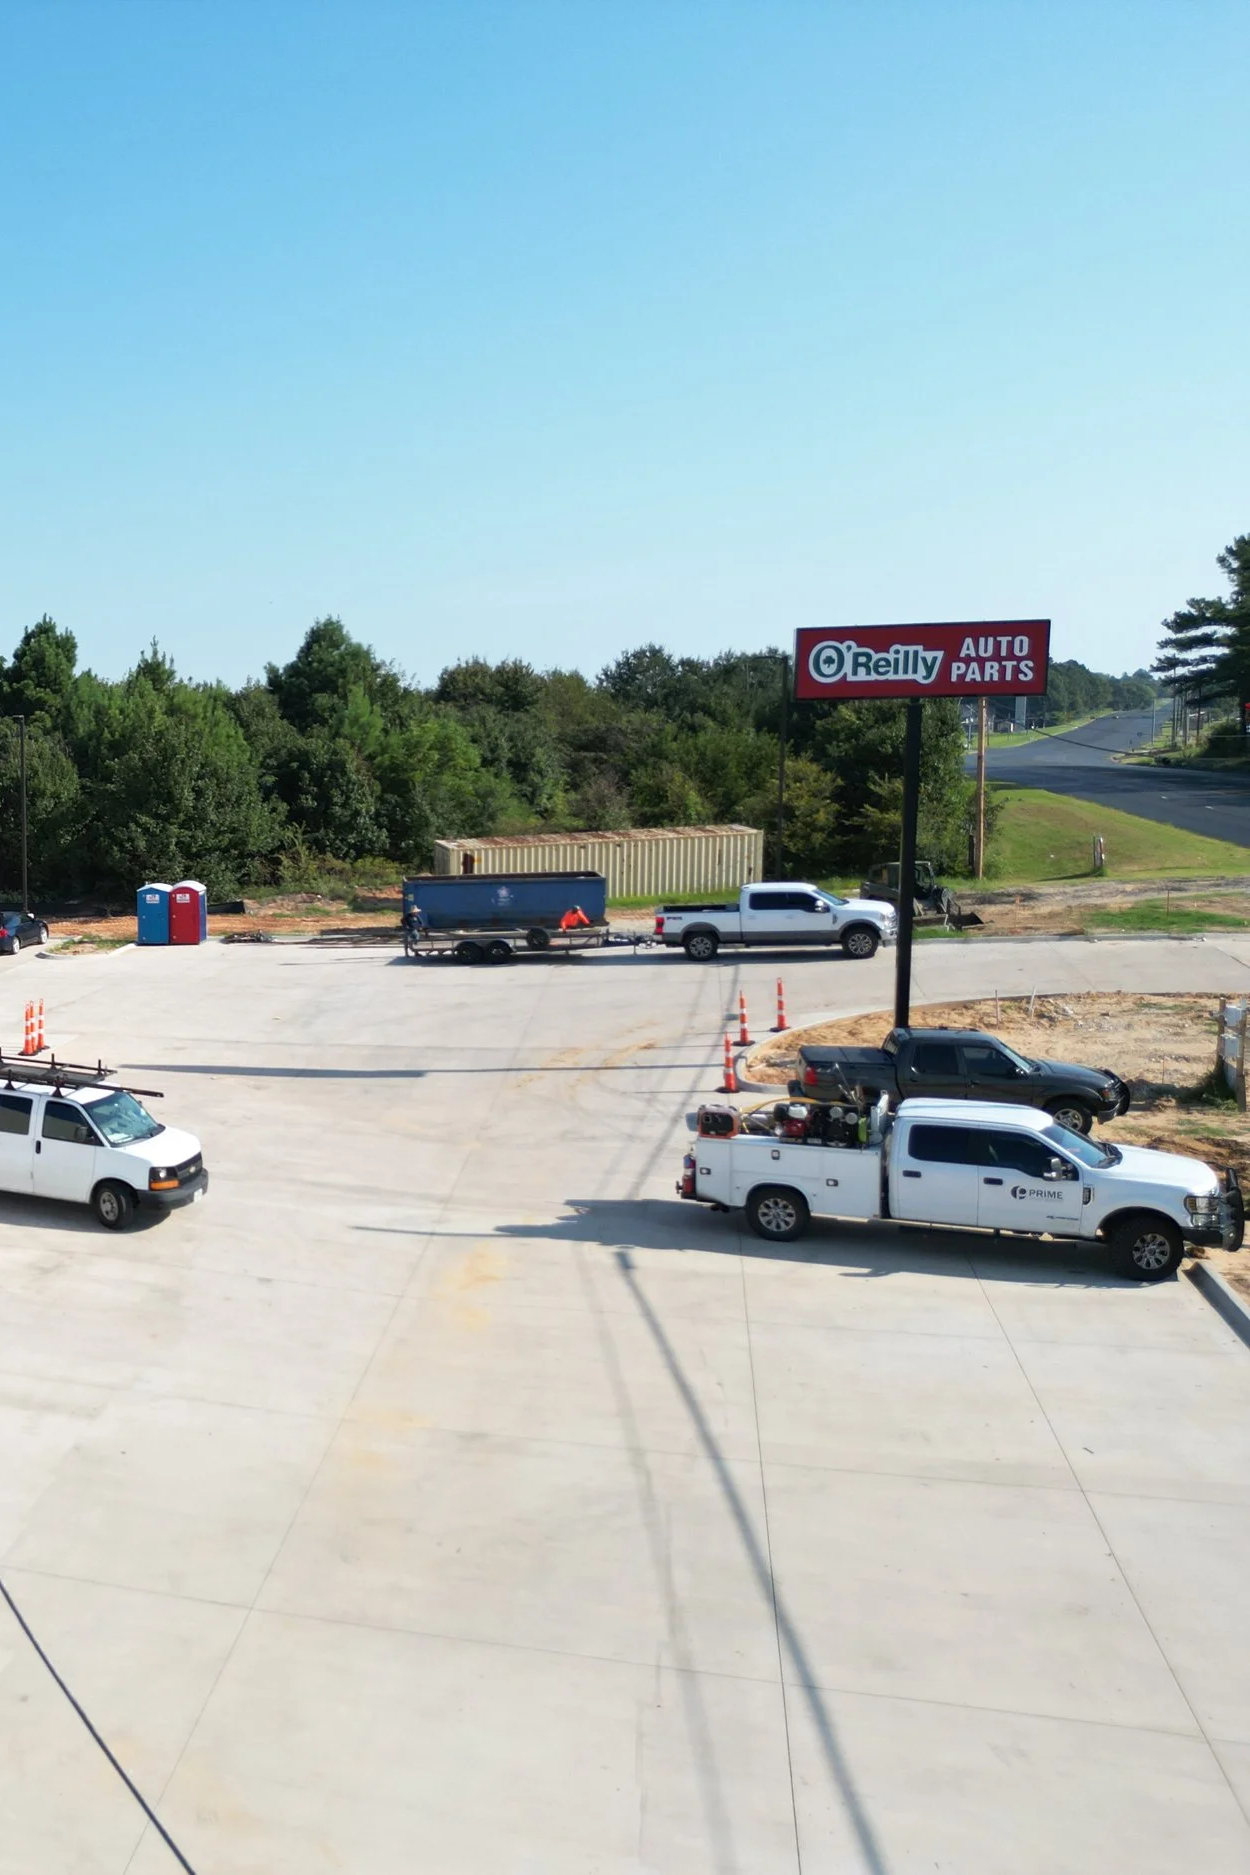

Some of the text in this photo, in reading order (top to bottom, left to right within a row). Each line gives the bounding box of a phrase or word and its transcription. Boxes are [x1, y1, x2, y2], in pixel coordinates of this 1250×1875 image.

[959, 635, 1030, 658] AUTO
[811, 643, 939, 681] O'Reilly
[950, 660, 1034, 682] PARTS
[1029, 1188, 1063, 1200] PRIME
